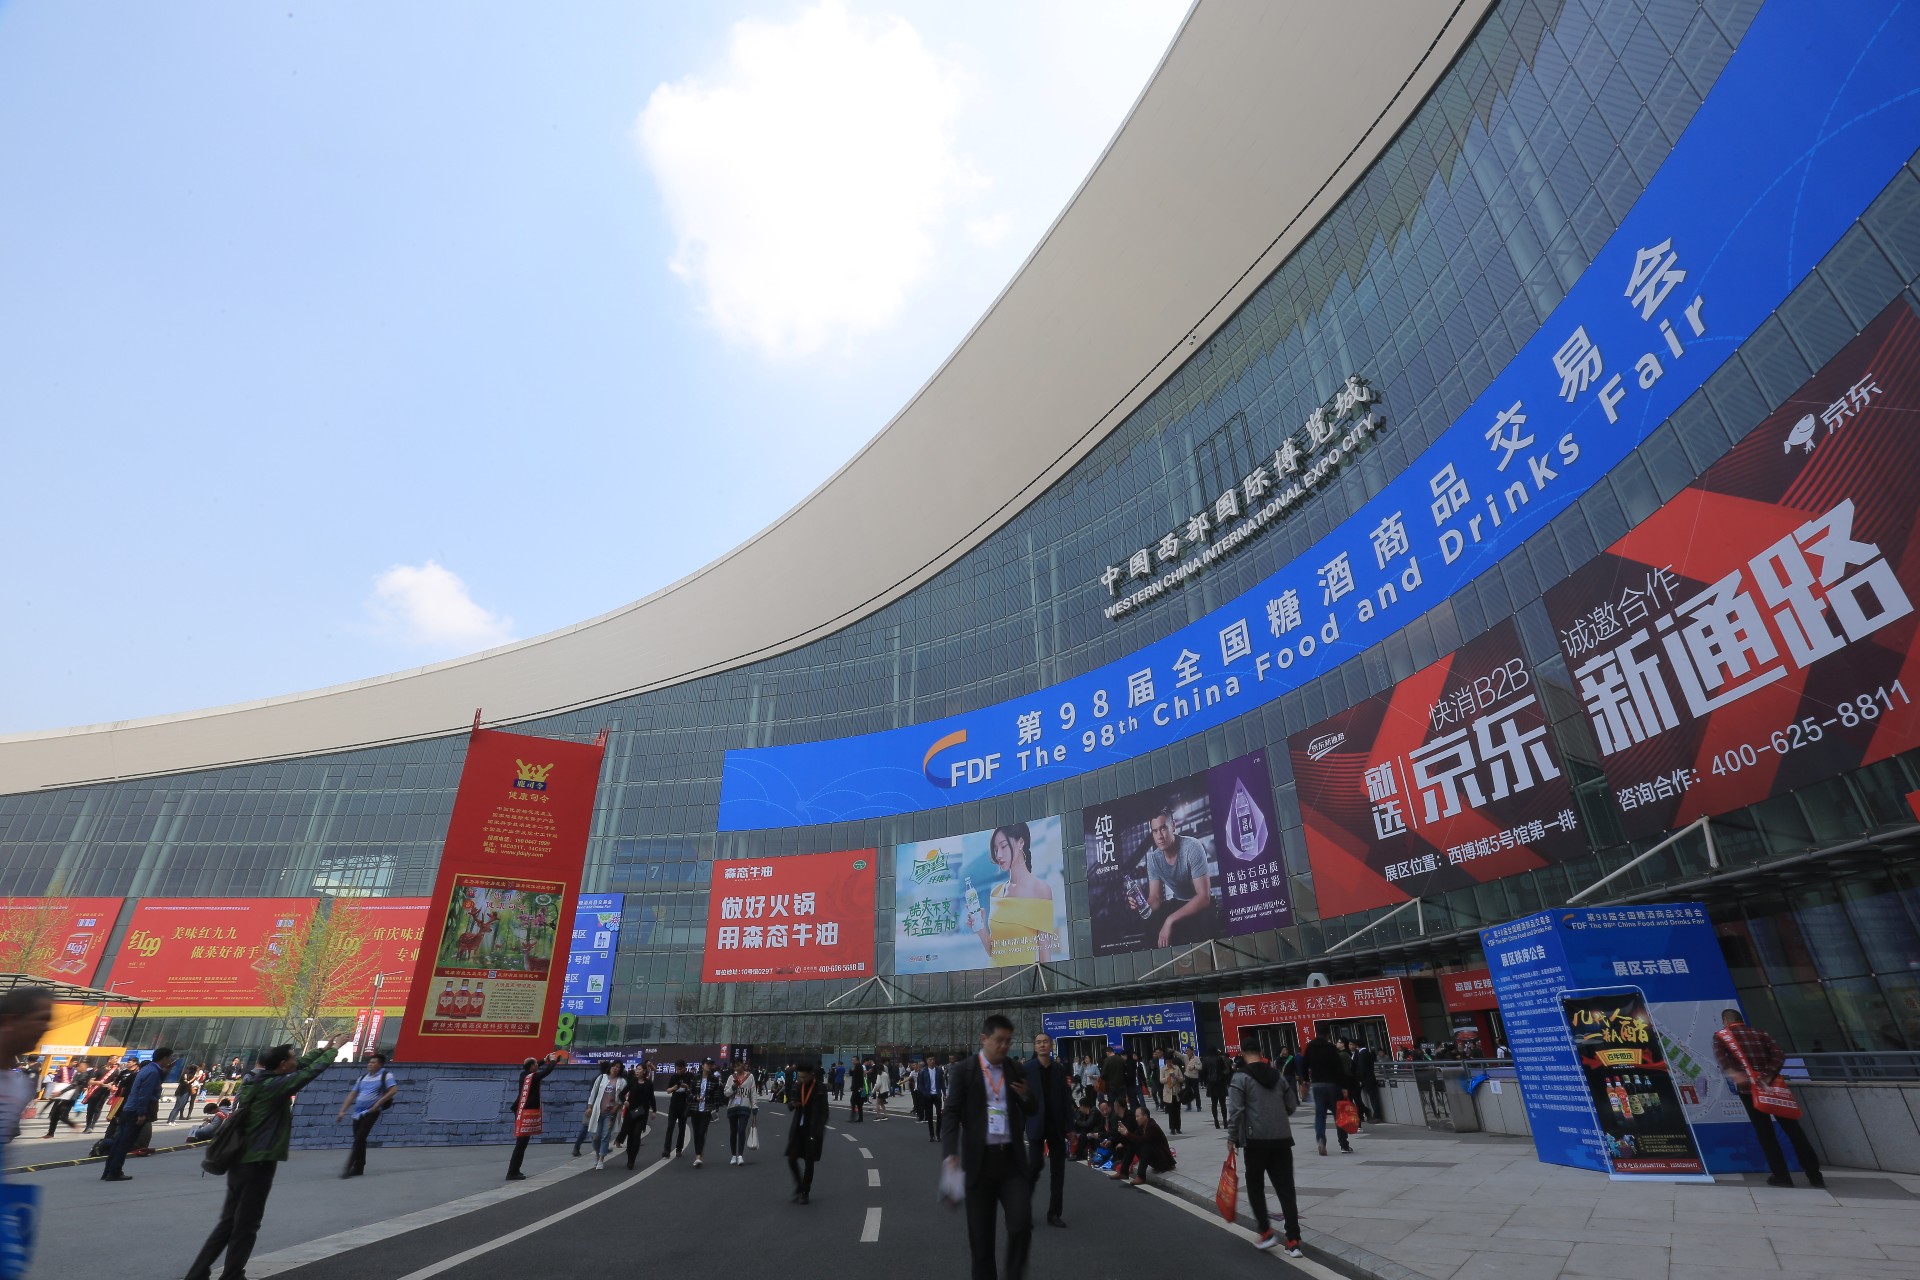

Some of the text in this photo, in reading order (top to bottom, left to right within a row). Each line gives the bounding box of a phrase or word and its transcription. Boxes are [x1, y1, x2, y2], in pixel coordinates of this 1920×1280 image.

[1819, 372, 1884, 434] 京东
[1016, 237, 1688, 746] 第98届全国糖酒商品交易会
[1100, 375, 1372, 595] 中国西部国际博览城
[1103, 412, 1376, 620] WESTERN CHINA INTERNATIONAL EXPO CITY
[1016, 294, 1706, 771] The 98th China Food and Drinks Fair
[1560, 563, 1680, 659] 诚邀合作
[1573, 497, 1915, 757] 新通路
[1428, 657, 1529, 731] 快消B2B
[950, 752, 1001, 788] FDF
[1408, 693, 1561, 825] 京东
[1094, 814, 1116, 865] 纯悦
[724, 865, 773, 880] 森态牛油
[1226, 860, 1279, 884] 选钻石品质
[721, 891, 816, 920] 做好火锅
[171, 926, 238, 940] 美味红九九
[717, 921, 839, 950] 用森态牛油
[1571, 922, 1587, 930] FDF
[191, 945, 260, 960] 做菜好帮手
[1500, 944, 1546, 967] 展区秩序公告
[1612, 958, 1690, 977] 展区示意图
[1353, 985, 1396, 1000] 京东超市
[1237, 1004, 1256, 1017] 京东
